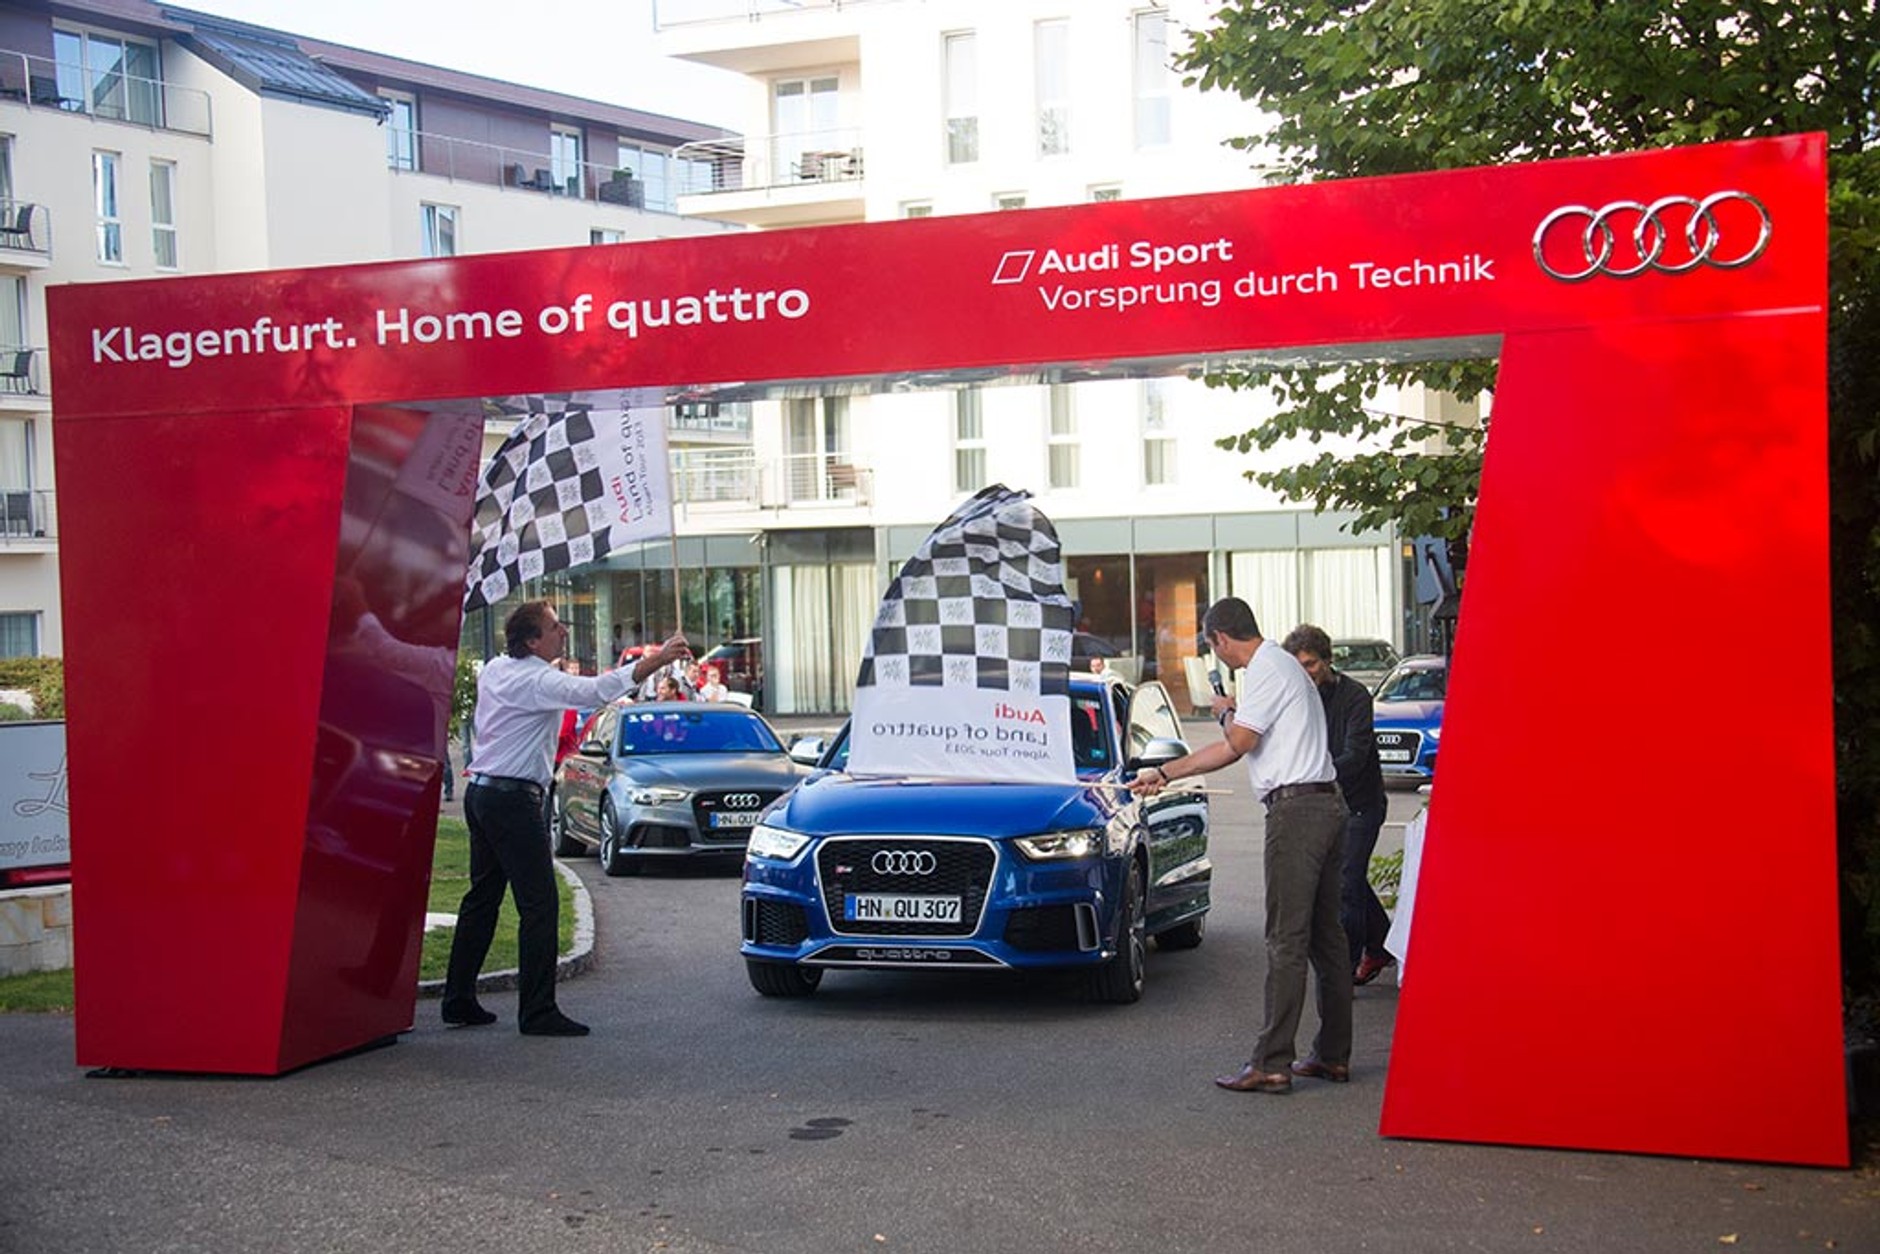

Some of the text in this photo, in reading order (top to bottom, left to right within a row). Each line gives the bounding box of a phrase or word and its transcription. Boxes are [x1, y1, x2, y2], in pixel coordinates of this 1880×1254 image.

[1038, 237, 1233, 275] Audi Sport
[1038, 253, 1495, 311] Vorsprung durch Technik
[92, 286, 811, 368] Klagenfurt. Home of quattro
[620, 443, 636, 466] of
[610, 475, 629, 524] Audi
[623, 470, 645, 522] Land
[856, 898, 960, 919] HN QU 307
[856, 948, 952, 961] quattro
